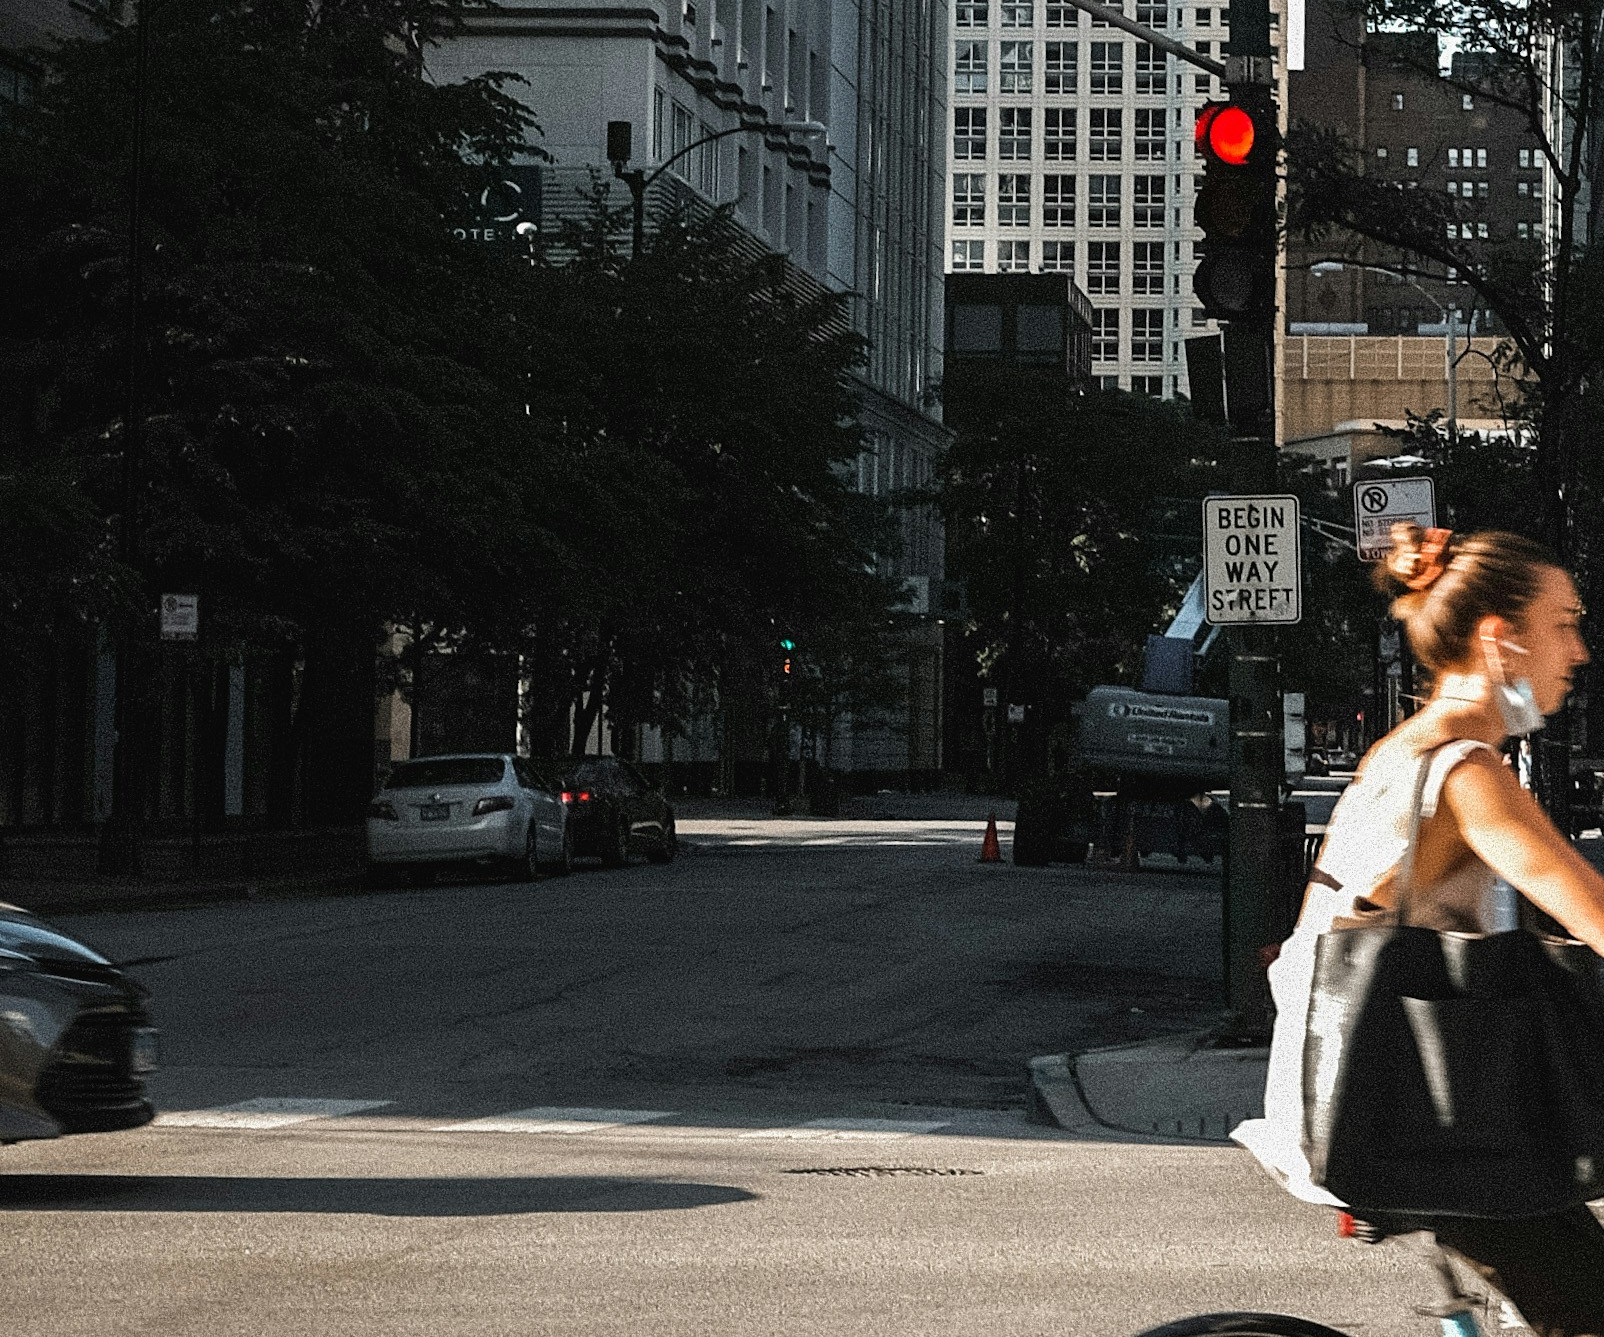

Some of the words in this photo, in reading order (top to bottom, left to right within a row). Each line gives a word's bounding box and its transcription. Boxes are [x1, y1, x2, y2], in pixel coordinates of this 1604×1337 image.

[1217, 508, 1285, 529] BEGIN
[1225, 534, 1279, 556] ONE
[1225, 561, 1279, 583] WAY
[1211, 588, 1294, 611] STREET
